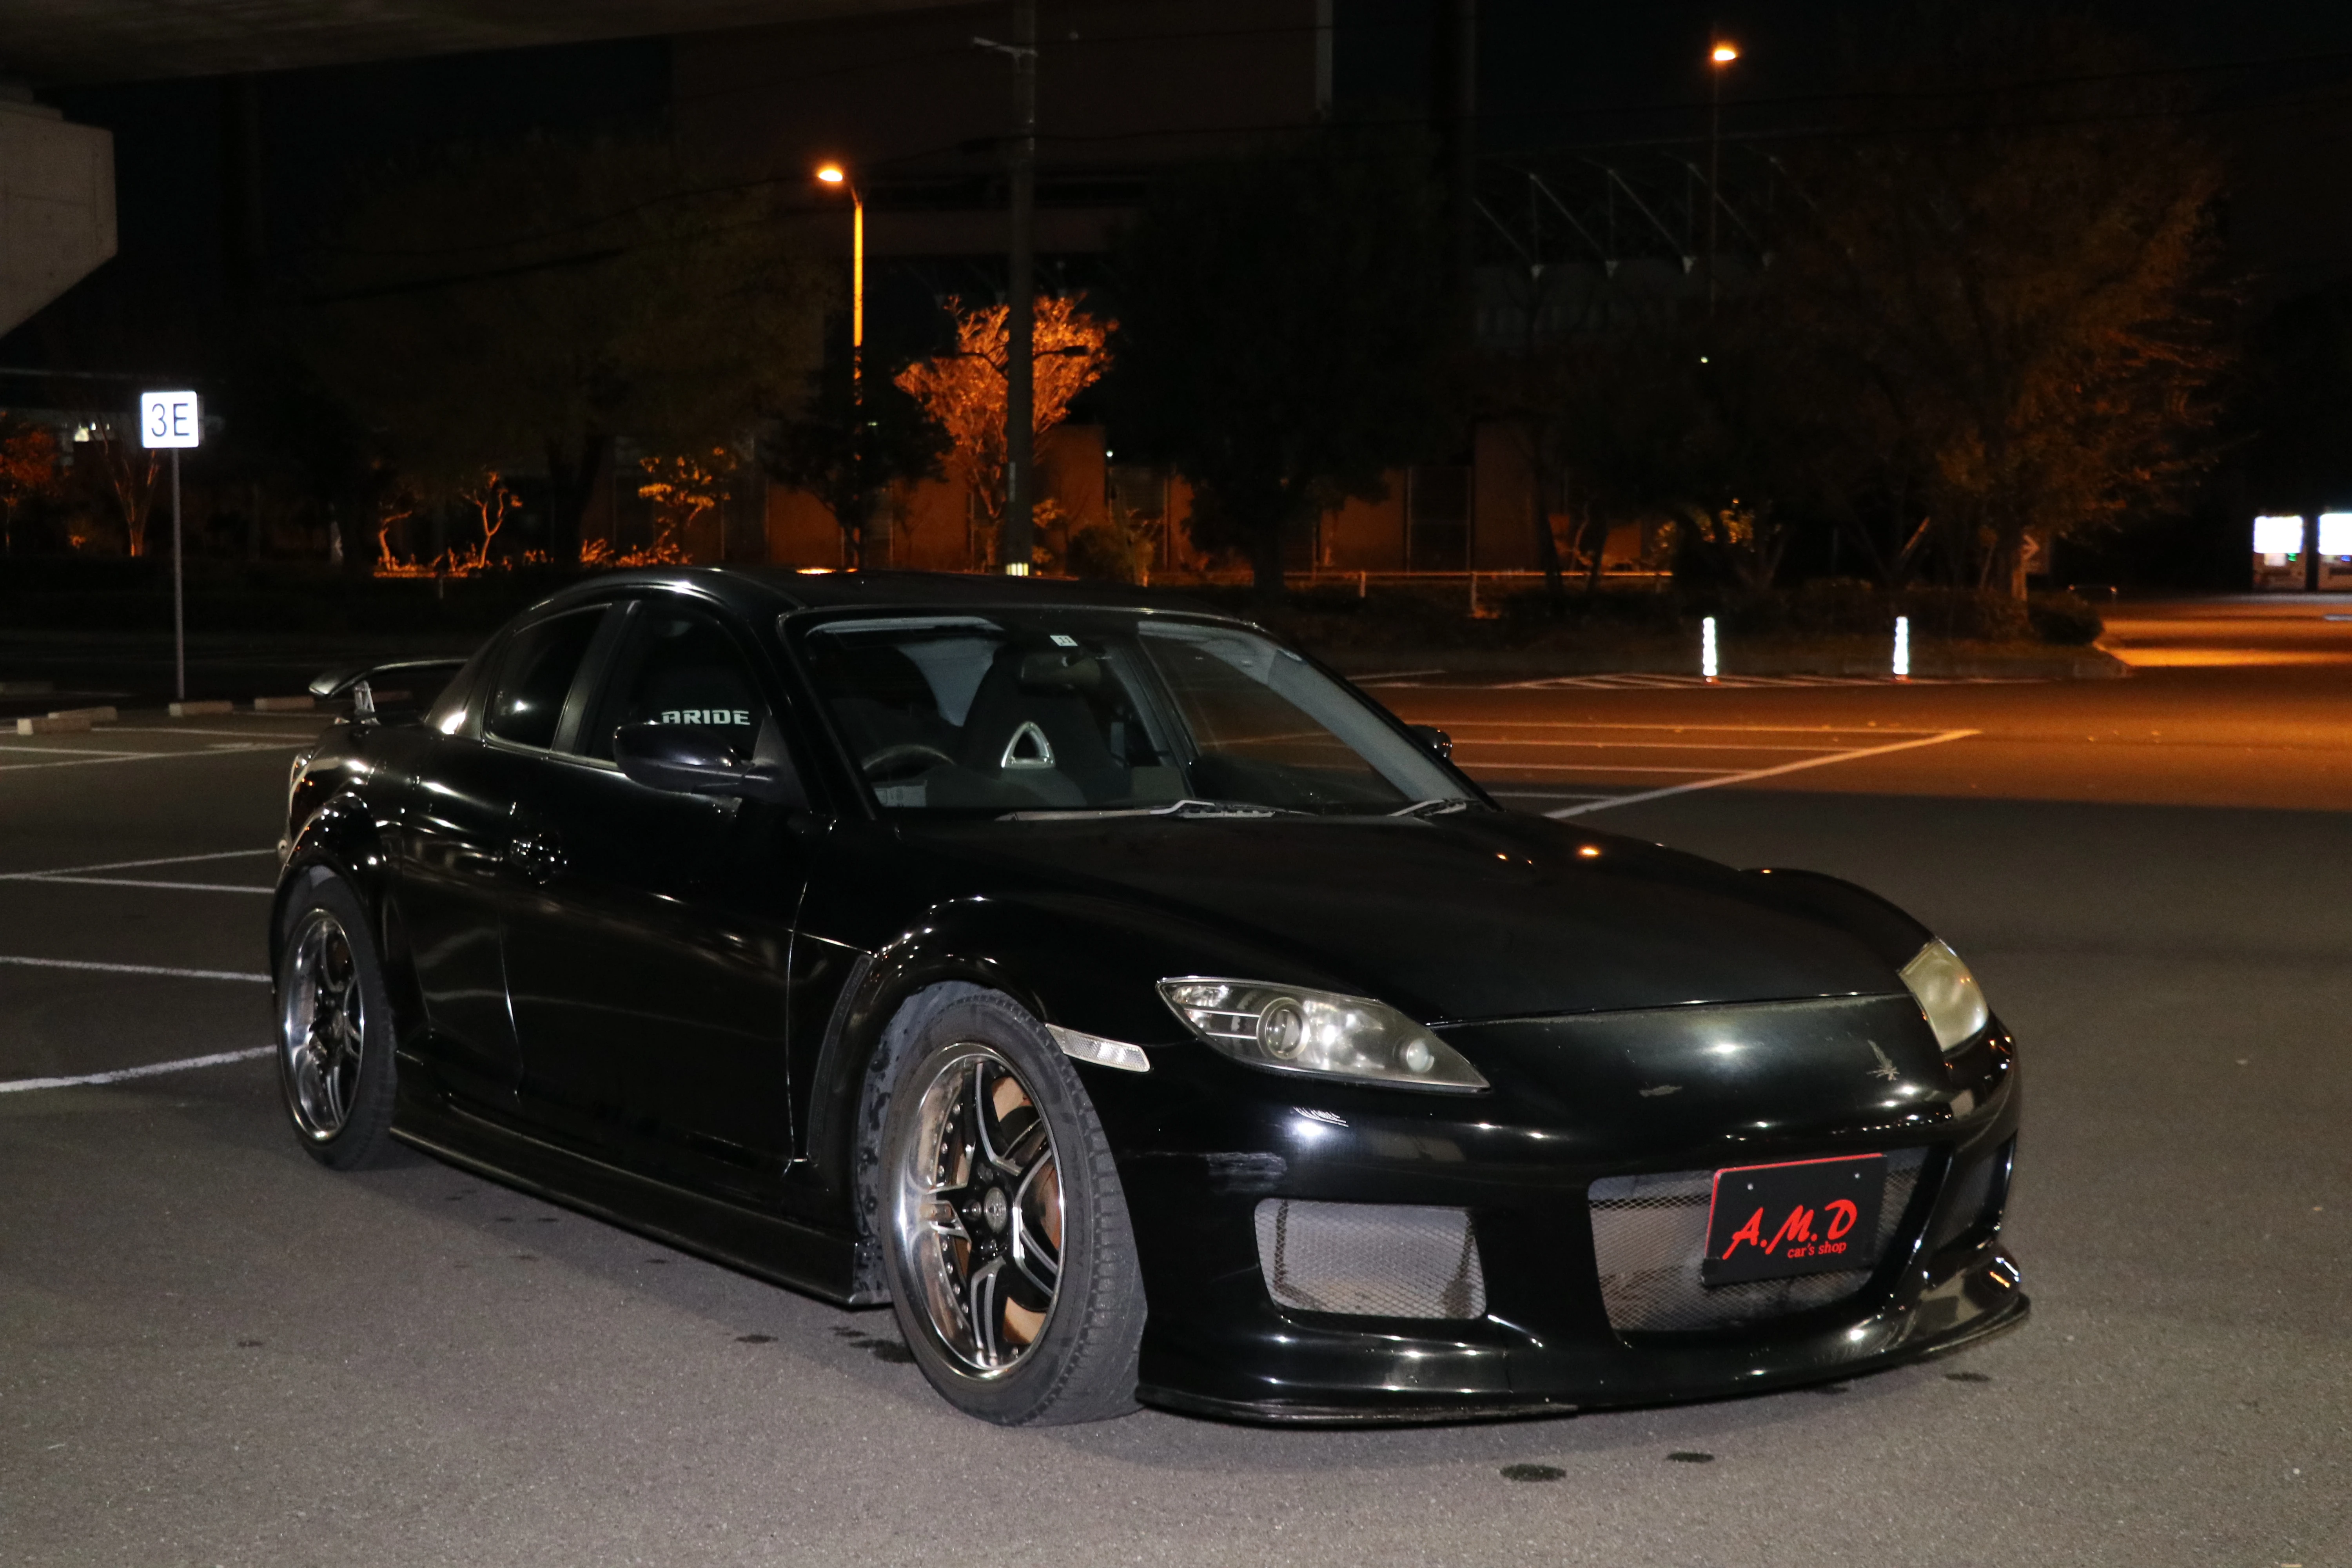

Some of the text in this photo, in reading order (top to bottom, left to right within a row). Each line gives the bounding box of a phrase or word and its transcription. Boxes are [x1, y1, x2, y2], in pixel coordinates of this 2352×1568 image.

[151, 403, 190, 437] 3E
[1722, 1199, 1858, 1260] A.M.D
[1787, 1241, 1847, 1258] car's shop
